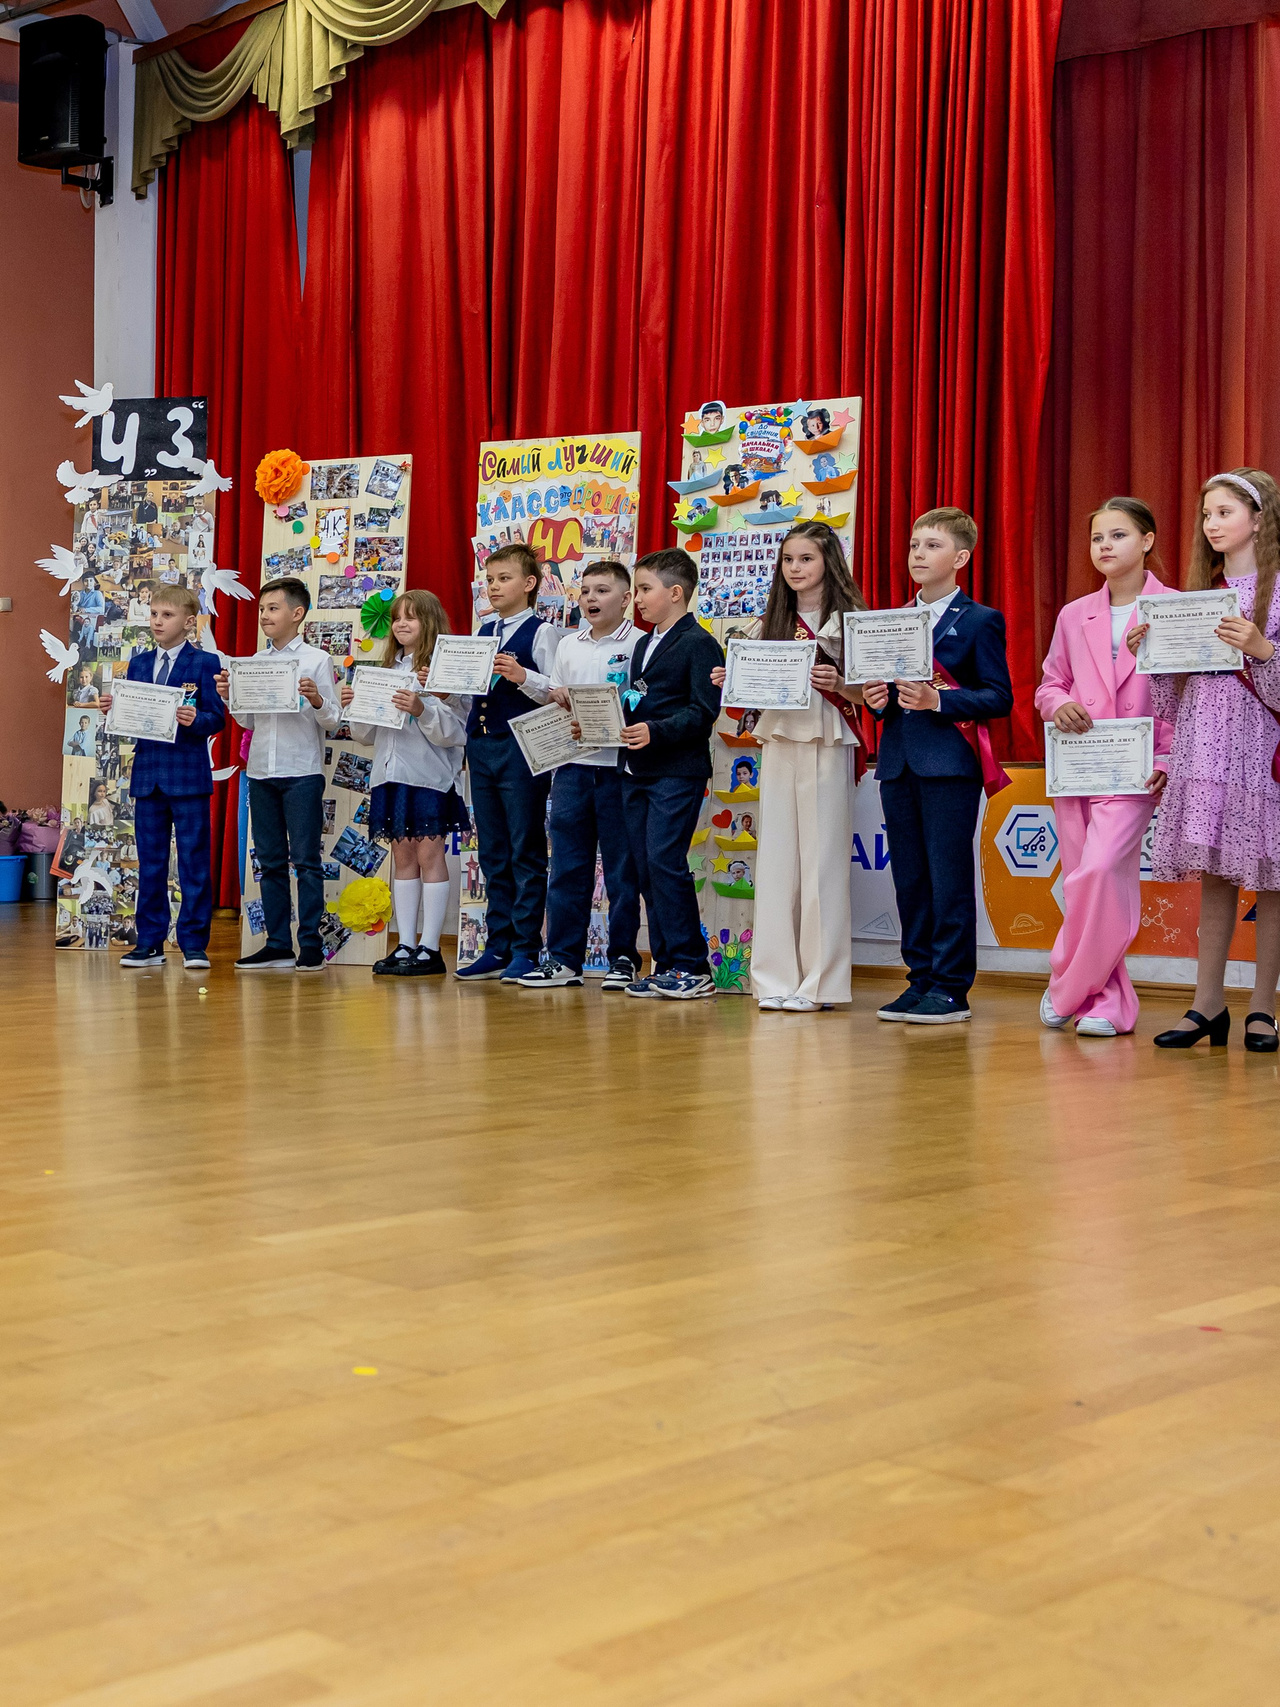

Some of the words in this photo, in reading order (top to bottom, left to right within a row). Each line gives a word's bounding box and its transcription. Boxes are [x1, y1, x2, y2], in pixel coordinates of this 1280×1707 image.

[481, 447, 542, 481] Самый
[547, 443, 636, 475] лучший
[479, 486, 560, 527] КЛАСС
[573, 486, 602, 509] ПРО
